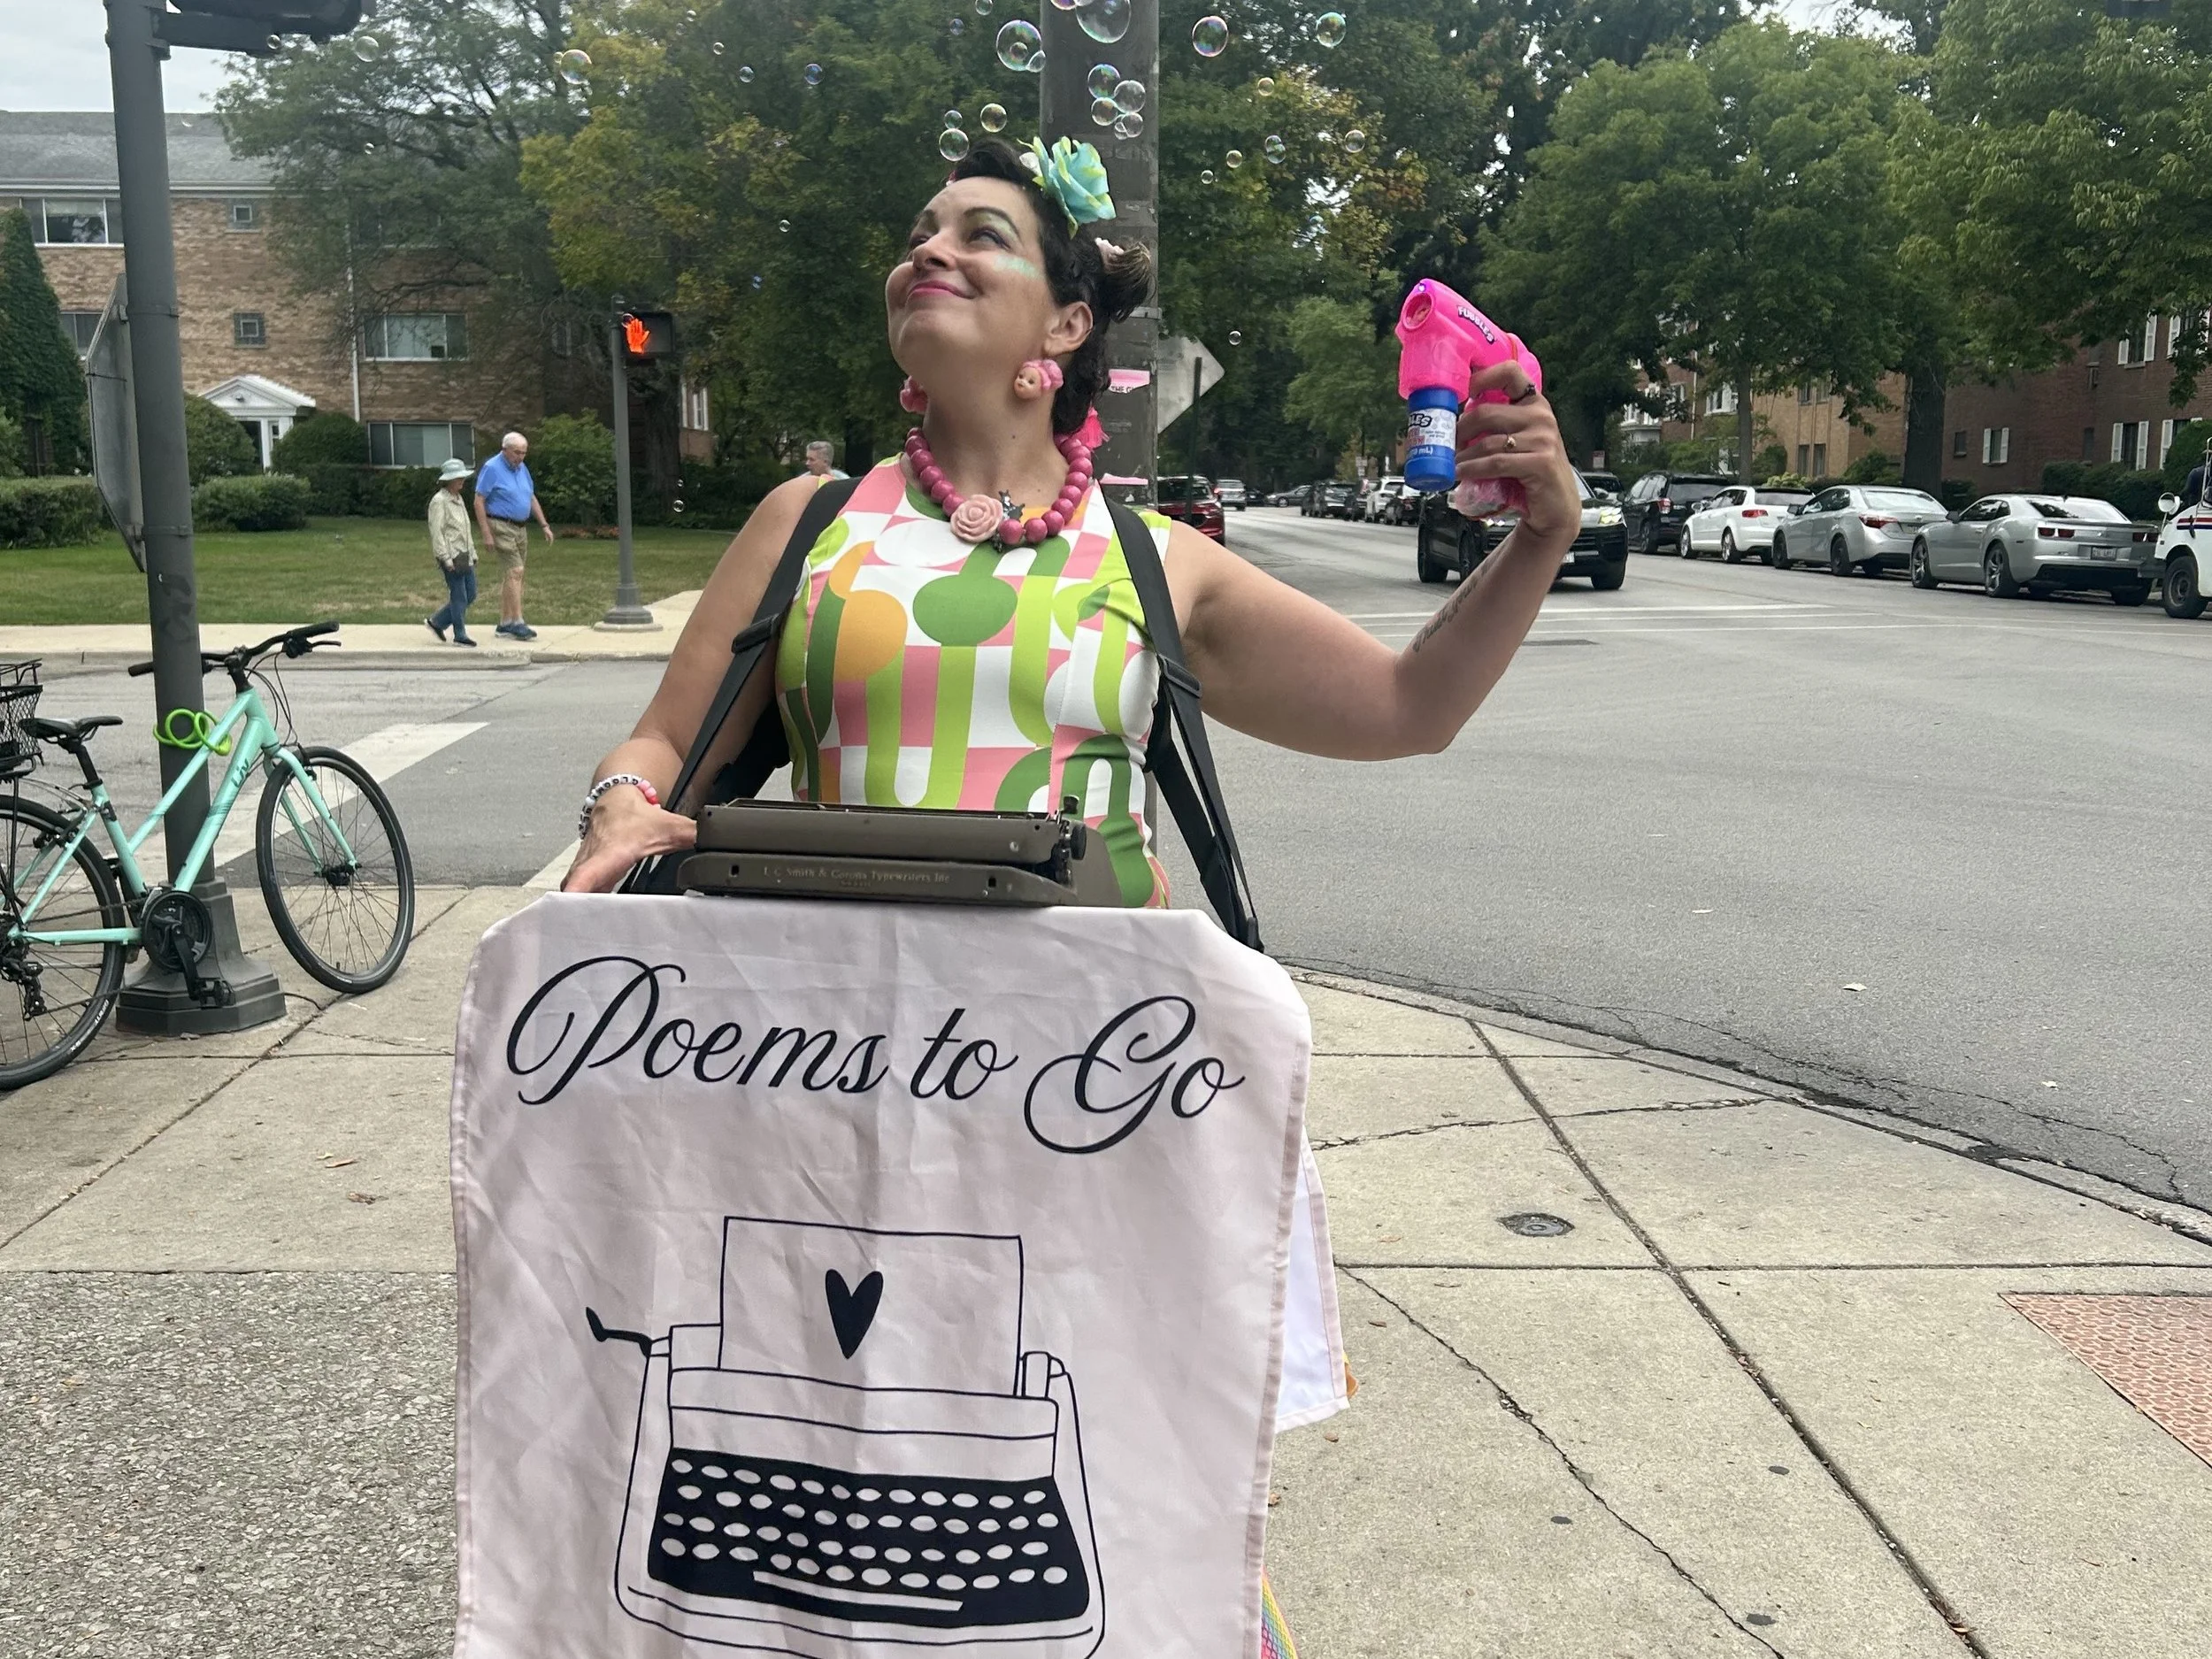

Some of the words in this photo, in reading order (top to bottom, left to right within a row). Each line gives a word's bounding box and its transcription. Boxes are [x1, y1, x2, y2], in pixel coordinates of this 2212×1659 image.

[230, 757, 250, 787] Liv
[786, 867, 815, 879] Smith
[818, 867, 827, 878] &
[831, 869, 868, 880] Corona
[507, 956, 887, 1106] Poems
[910, 1008, 1018, 1100] to
[1024, 995, 1245, 1154] Go
